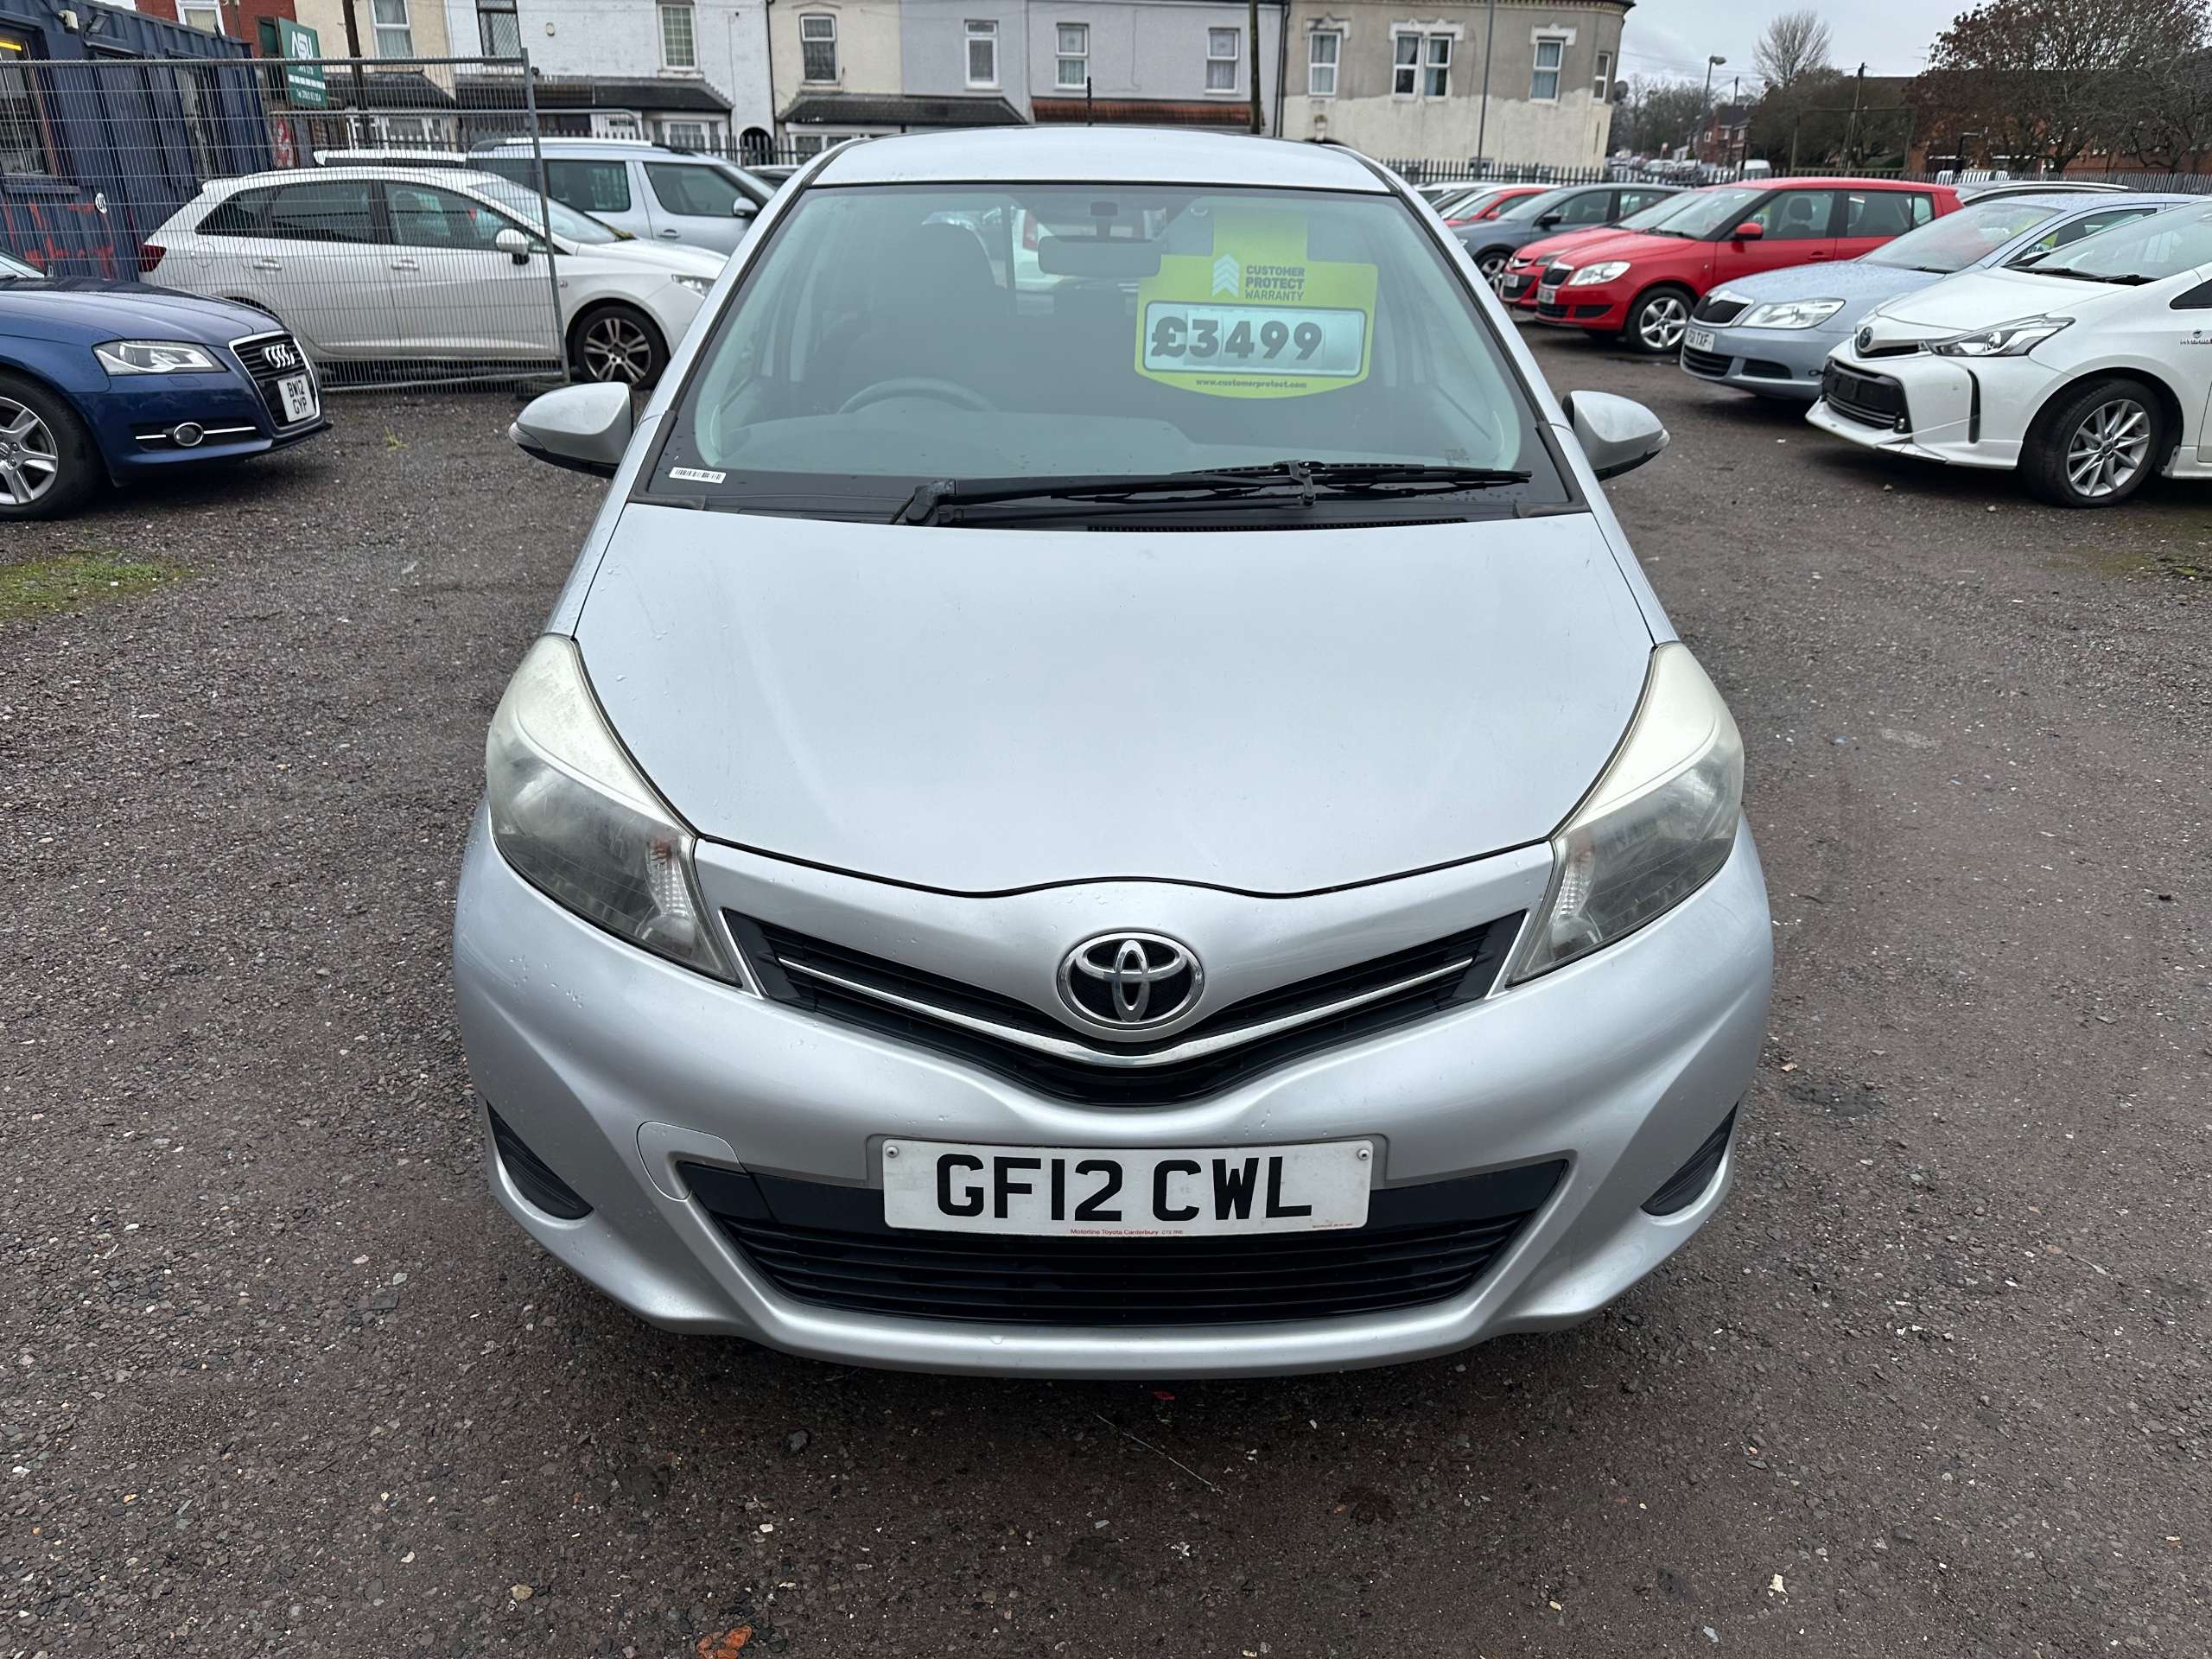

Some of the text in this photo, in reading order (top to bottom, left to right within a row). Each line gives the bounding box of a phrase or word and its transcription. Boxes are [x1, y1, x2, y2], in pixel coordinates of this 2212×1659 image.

[1246, 264, 1305, 276] CUSTOMER
[1245, 276, 1305, 289] PROTECT
[1245, 289, 1304, 302] WARRANTY
[1151, 316, 1322, 360] £3499
[1196, 378, 1307, 389] www.customerprotect.com
[292, 397, 308, 415] GYP
[936, 1154, 1313, 1222] GF12 CWL
